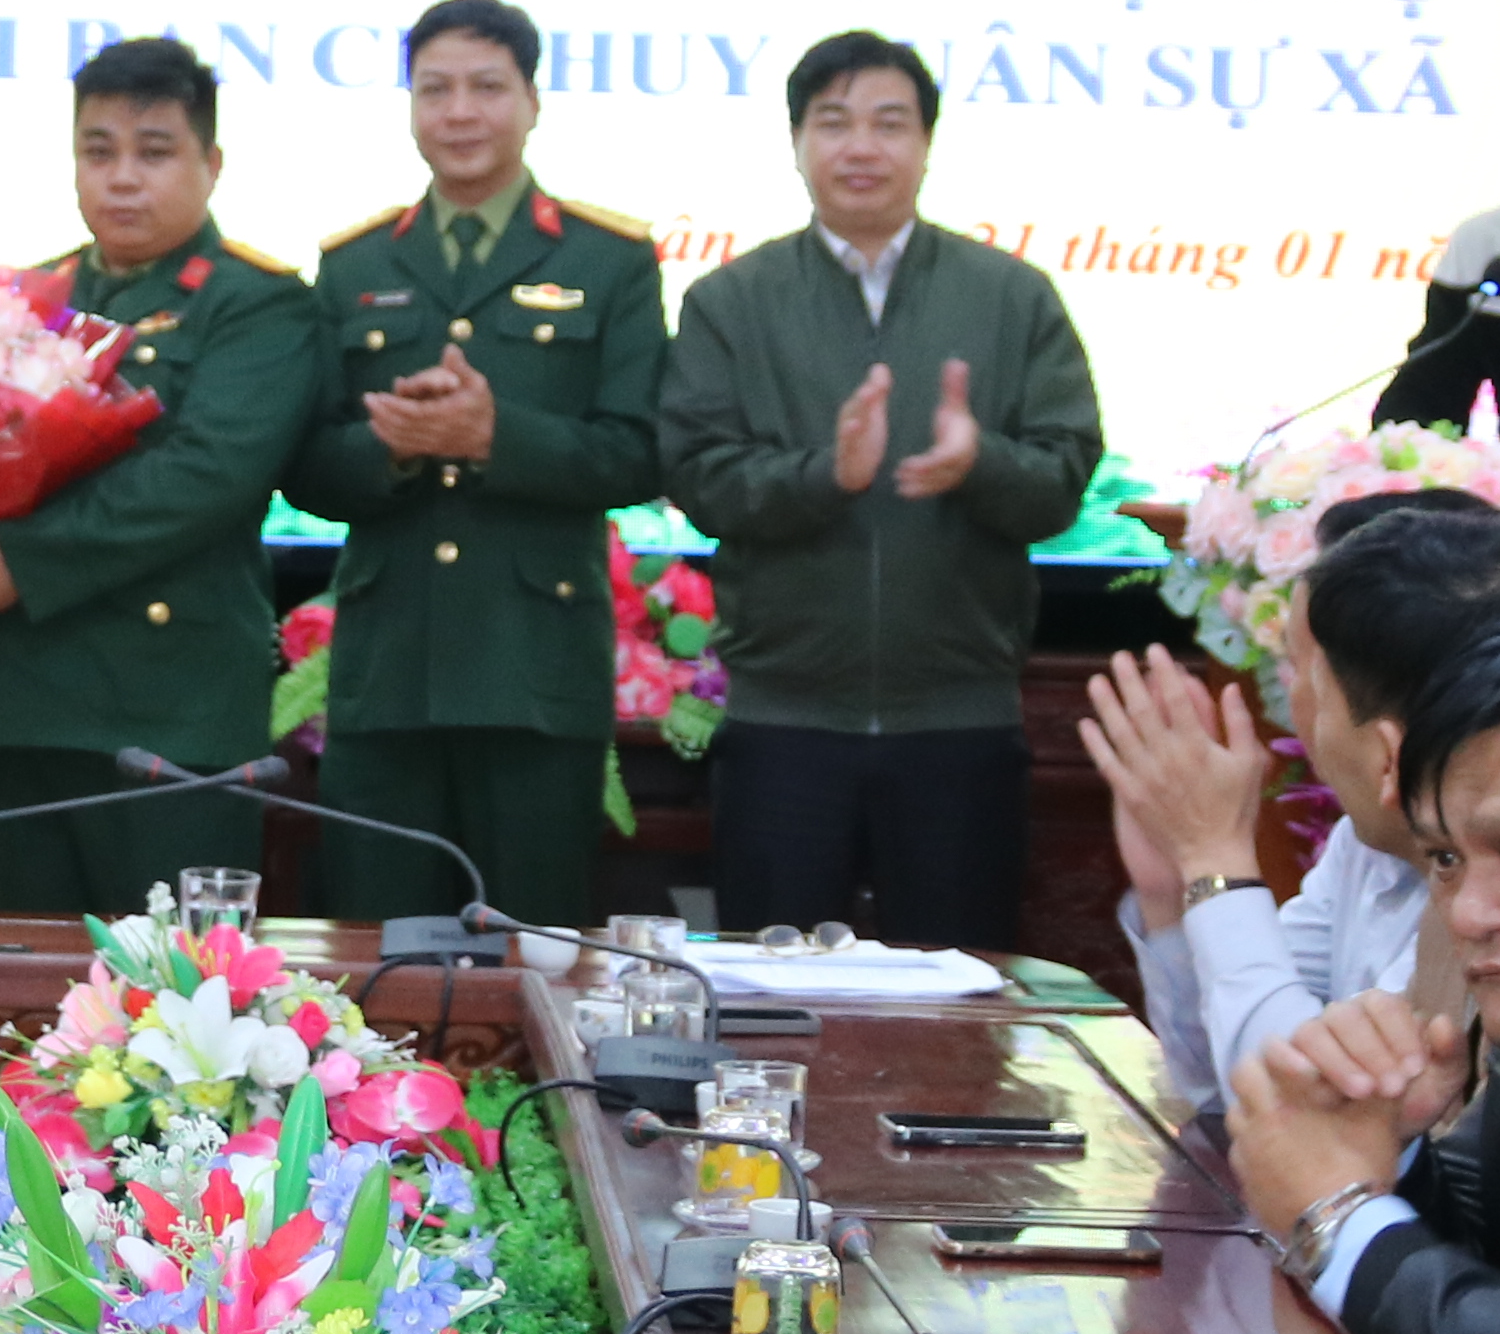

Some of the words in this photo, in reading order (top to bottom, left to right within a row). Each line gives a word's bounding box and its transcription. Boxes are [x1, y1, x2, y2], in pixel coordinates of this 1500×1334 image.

[547, 31, 770, 96] HUY
[1143, 36, 1292, 129] SỰ
[1315, 35, 1462, 116] XÃ
[1061, 225, 1250, 290] tháng
[1275, 229, 1346, 279] 01
[1372, 235, 1450, 281] nă
